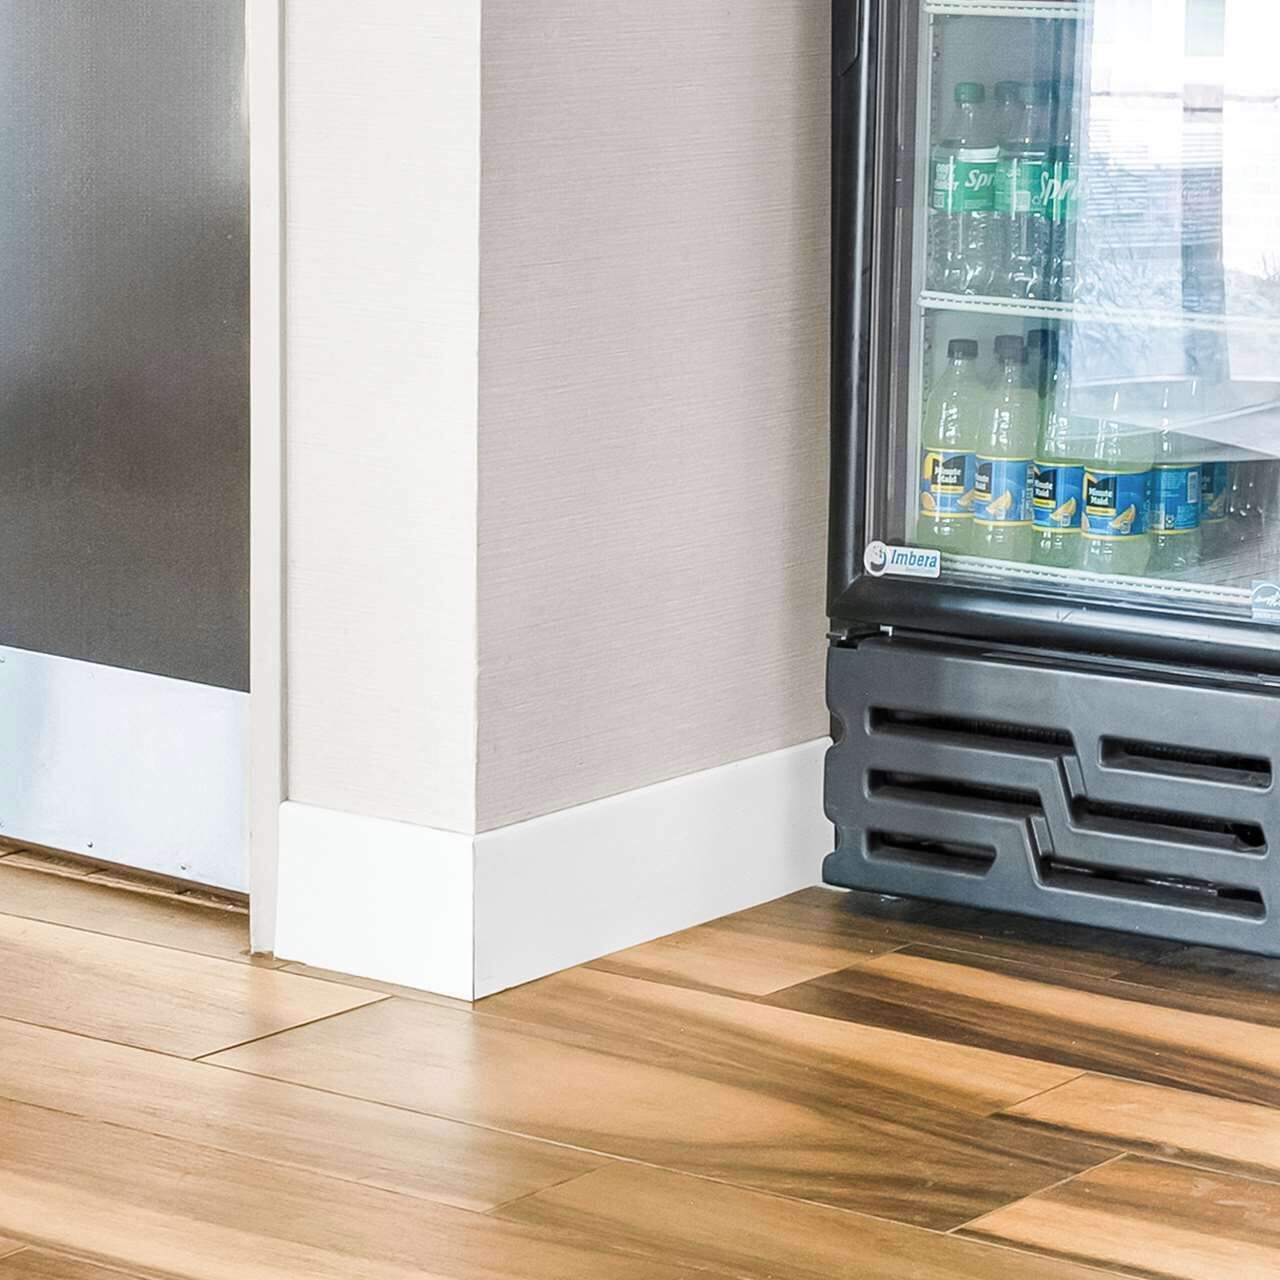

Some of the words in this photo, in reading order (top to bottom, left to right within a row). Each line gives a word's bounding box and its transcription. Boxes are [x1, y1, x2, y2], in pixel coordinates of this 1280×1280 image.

[1088, 486, 1114, 498] Minute
[1089, 496, 1111, 507] Maid
[890, 549, 939, 569] Imbera
